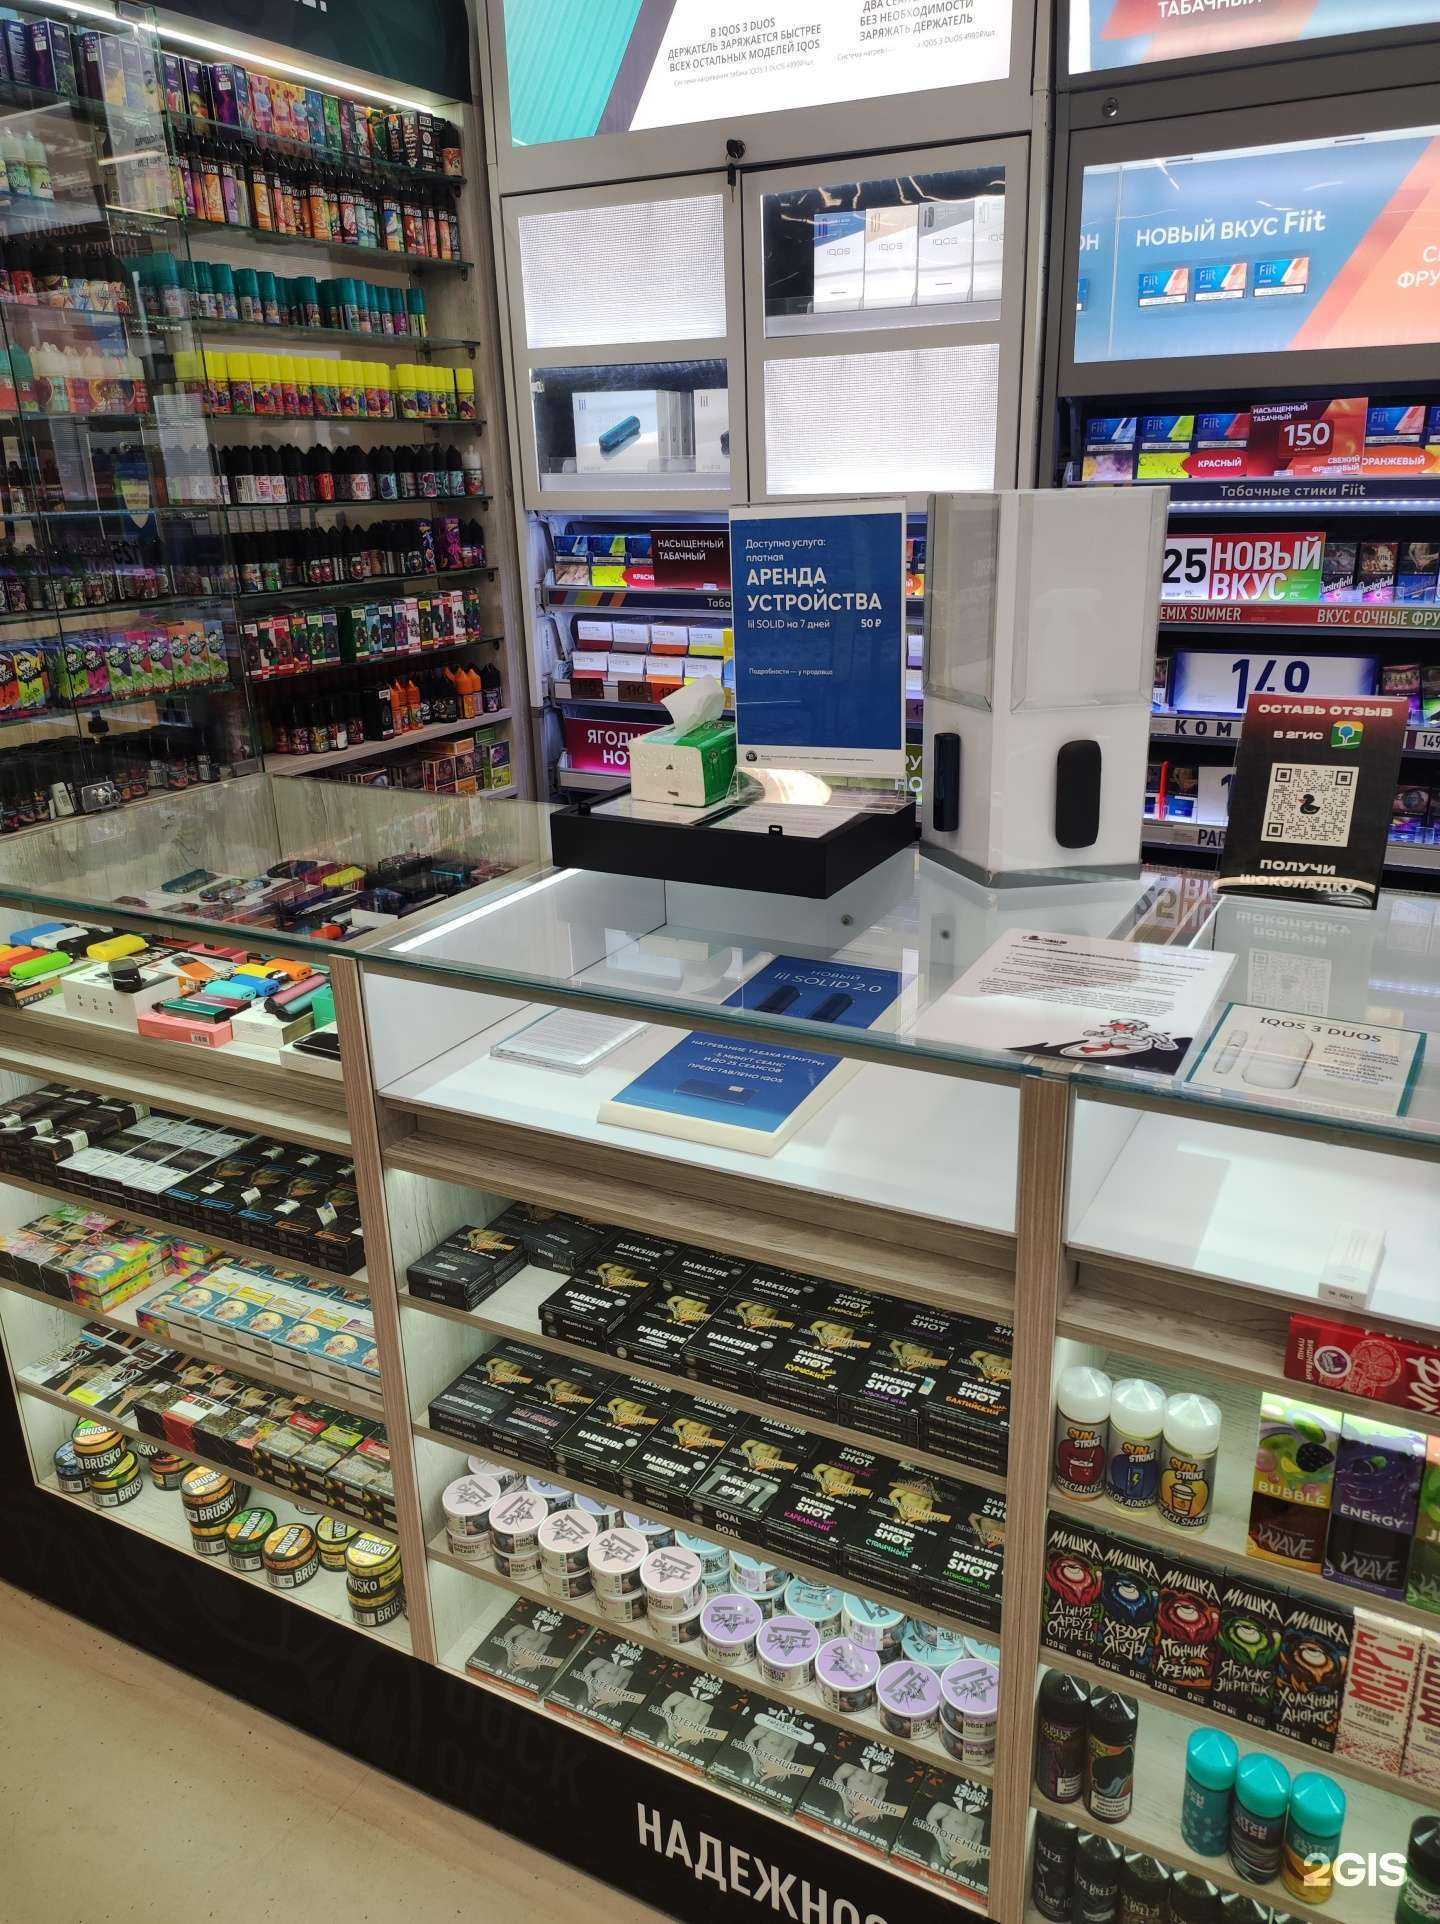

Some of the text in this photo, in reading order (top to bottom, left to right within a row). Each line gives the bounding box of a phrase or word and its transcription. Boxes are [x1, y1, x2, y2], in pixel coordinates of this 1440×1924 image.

[860, 15, 877, 27] БЕЗ
[880, 0, 974, 18] НЕОБХОДИМОСТИ
[1158, 0, 1263, 18] ТАБАЧН
[710, 17, 776, 38] В IQOS 3 DUOS
[860, 13, 974, 42] ЗАРЯЖАТЬ ДЕРЖАТЕЛЬ
[668, 24, 822, 61] ДЕРЖАТЕЛЬ ЗАРЯЖАЕТСЯ БЫСТРЕЕ
[669, 39, 820, 72] ВСЕХ ОСТАЛЬНЫХ МОДЕЛЕЙ IQOS
[1136, 207, 1326, 248] НОВЫЙ ВКУС Fiit
[1199, 269, 1217, 281] Fiit
[1259, 262, 1279, 276] Fiit
[1143, 274, 1161, 287] Fiit
[1253, 403, 1308, 416] НАСЫЩЕННЫЙ
[1253, 412, 1292, 422] ТАБАЧНЫЙ
[1371, 411, 1389, 423] Fiit
[1147, 418, 1163, 430] Fiit
[1202, 417, 1220, 429] Fiit
[1284, 422, 1331, 447] 150
[1198, 457, 1242, 468] КРАСНЫЙ
[1362, 456, 1425, 467] ОРАНЖЕВЫЙ
[1220, 483, 1366, 499] Табачные стики Fiit
[657, 538, 724, 550] НАСЫЩЕННЫЙ
[745, 538, 827, 550] Доступно услуга:
[659, 550, 706, 561] ТАБАЧНЫЙ
[746, 554, 784, 562] платная
[1213, 536, 1322, 571] НОВЫЙ
[746, 567, 827, 587] АРЕНДА
[1210, 572, 1288, 600] ВКУС
[747, 588, 882, 612] УСТРОЙСТВА
[860, 618, 874, 628] 50
[1190, 607, 1241, 621] SUMMER
[1317, 608, 1350, 623] ВКУС
[1354, 609, 1408, 625] СОЧНЫЕ
[756, 619, 785, 629] SOLID
[800, 619, 805, 628] 7
[807, 618, 831, 630] дней
[749, 667, 790, 676] Подробности
[1258, 703, 1393, 718] ОСТАВЬ ОТЗЫВ
[1273, 731, 1324, 741] В 2ГИС
[603, 750, 631, 765] НО
[1260, 859, 1336, 876] ПОЛУЧИ
[1238, 874, 1358, 893] ШОКОЛАДКУ
[792, 975, 882, 994] SOLID 2.0
[1258, 1016, 1383, 1044] IQOS 3 DUOS
[691, 1039, 825, 1066] НАГРЕВАНИЕ ТАБАКА ИЗНУТРИ
[722, 1053, 756, 1066] МИНУТ
[687, 1061, 784, 1084] ПРЕДСТАВЛЕНО IQOS
[739, 1062, 782, 1073] СЕАНСОВ
[616, 1242, 662, 1259] DARKSIDE
[681, 1259, 730, 1278] DARKSIDE
[752, 1278, 801, 1296] DARKSIDE
[564, 1290, 614, 1309] DARKSIDE
[834, 1298, 869, 1311] SHOT
[910, 1320, 947, 1334] SHOT
[914, 1313, 950, 1328] DARKSIDE
[637, 1325, 688, 1345] DARKSIDE
[706, 1331, 760, 1352] DARKSIDE
[792, 1354, 831, 1370] SHOT
[865, 1379, 913, 1398] SHOT
[871, 1372, 917, 1390] DARKSIDE
[961, 1381, 1001, 1398] DARKSIDE
[957, 1387, 999, 1404] SHOT
[693, 1395, 740, 1415] DARKSIDE
[80, 1425, 112, 1436] BRUSK
[760, 1416, 808, 1436] DARKSIDE
[1068, 1428, 1096, 1440] SUN
[577, 1430, 625, 1450] DARKSIDE
[1074, 1437, 1101, 1448] STRIKE
[1122, 1443, 1149, 1455] SUN
[83, 1447, 122, 1470] BRUSKO
[838, 1451, 873, 1468] SHOT
[843, 1447, 877, 1461] DARKSIDE
[1129, 1452, 1155, 1463] STRIKE
[642, 1453, 691, 1475] DARKSIDE
[1170, 1457, 1198, 1472] SUN
[188, 1470, 221, 1490] BRUSK
[720, 1474, 762, 1493] DARKSIDE
[1175, 1470, 1203, 1480] STRIKE
[721, 1485, 745, 1499] GOAL
[1258, 1481, 1328, 1506] BUBBLE
[198, 1495, 236, 1521] BRUSKO
[795, 1502, 833, 1521] SHOT
[800, 1496, 836, 1513] DARKSIDE
[715, 1510, 742, 1525] GOAL
[1340, 1503, 1404, 1529] ENERGY
[238, 1512, 261, 1539] BRUSKO
[715, 1523, 742, 1538] GOAL
[878, 1522, 916, 1540] DARKSIDE
[275, 1527, 300, 1555] BRUSKO
[354, 1538, 390, 1555] BRUSKO
[874, 1528, 913, 1547] SHOT
[1048, 1531, 1104, 1560] МИШКА
[1259, 1524, 1315, 1560] WAVE
[947, 1558, 996, 1580] SHOT
[952, 1550, 999, 1571] DARKSIDE
[1104, 1549, 1160, 1583] МИШКА
[1340, 1552, 1400, 1581] WAVE
[1160, 1570, 1222, 1605] МИШКА
[1224, 1588, 1284, 1624] МИШКА
[1283, 1611, 1349, 1645] МИШКА
[731, 1738, 805, 1776] ИМПОТЕНЦИЯ
[819, 1776, 898, 1815] ИМПОТЕНЦИЯ
[912, 1817, 991, 1857] ИМПОТЕНЦИ
[637, 1802, 889, 1924] НАДЕЖНО
